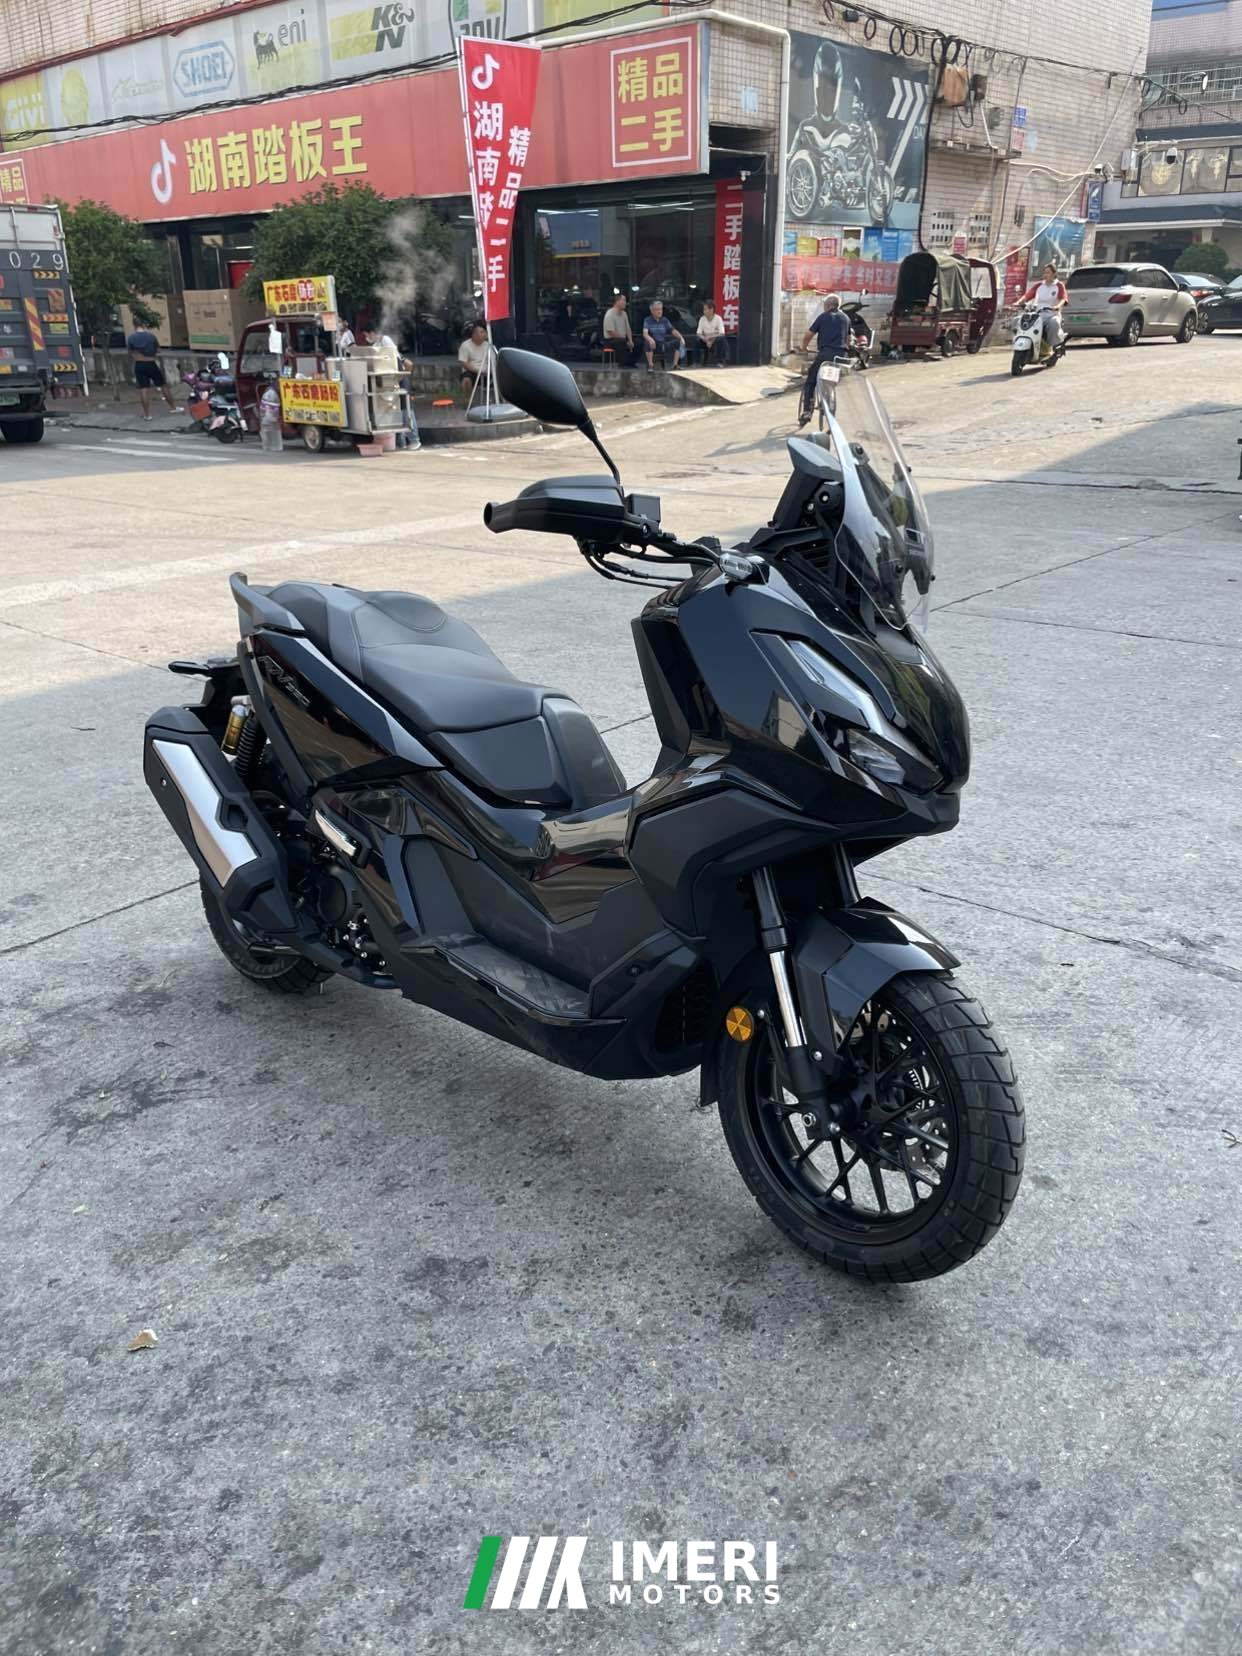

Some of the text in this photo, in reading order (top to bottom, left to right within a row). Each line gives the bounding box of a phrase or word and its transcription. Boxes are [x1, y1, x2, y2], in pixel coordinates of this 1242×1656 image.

[278, 8, 307, 47] eni
[180, 51, 226, 88] SHOEI
[617, 52, 684, 104] 精品
[184, 115, 368, 194] 湖南踏板王
[619, 107, 685, 152] 二手
[488, 125, 532, 293] 精品二手
[722, 184, 743, 330] 二手踏板车
